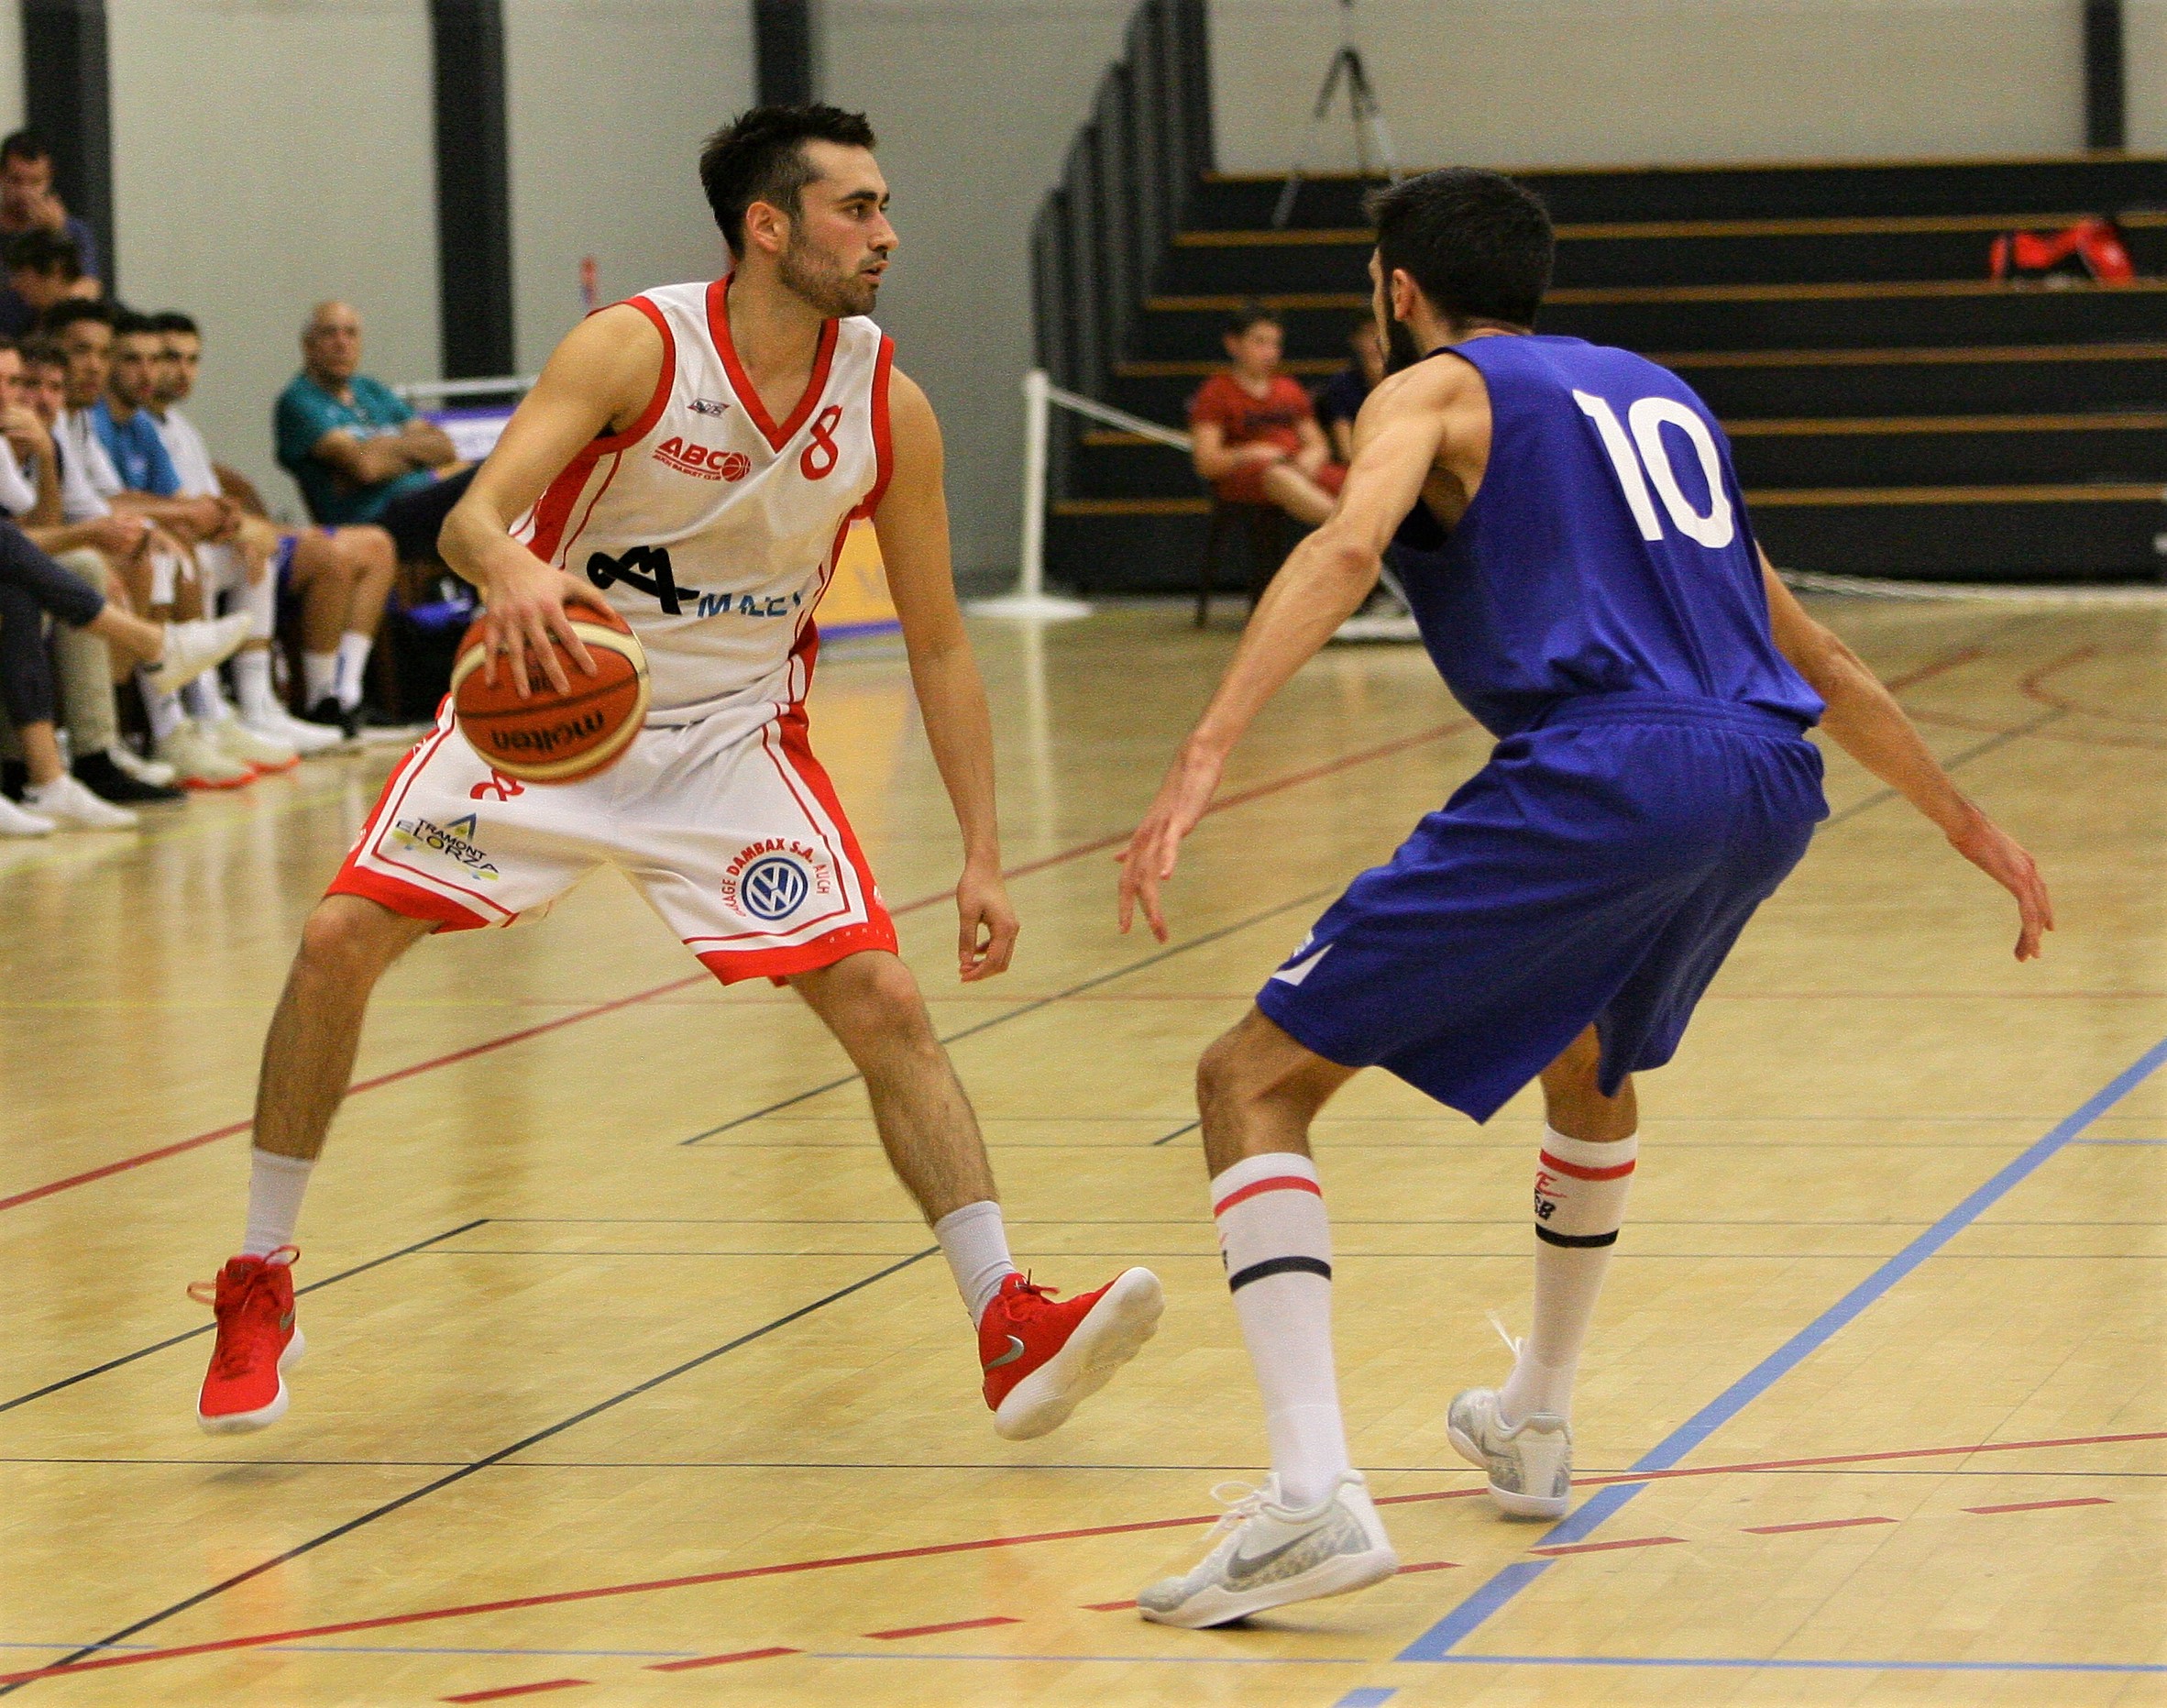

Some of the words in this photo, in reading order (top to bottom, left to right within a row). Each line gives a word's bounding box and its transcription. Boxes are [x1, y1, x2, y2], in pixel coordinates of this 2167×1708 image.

[657, 436, 732, 470] ABC
[799, 404, 842, 480] 8
[1572, 389, 1734, 548] 10
[490, 710, 605, 753] molten
[418, 818, 488, 860] TRAMONT
[726, 838, 786, 877] DAMBAX
[789, 841, 814, 864] S.A.
[813, 864, 830, 895] AUCH
